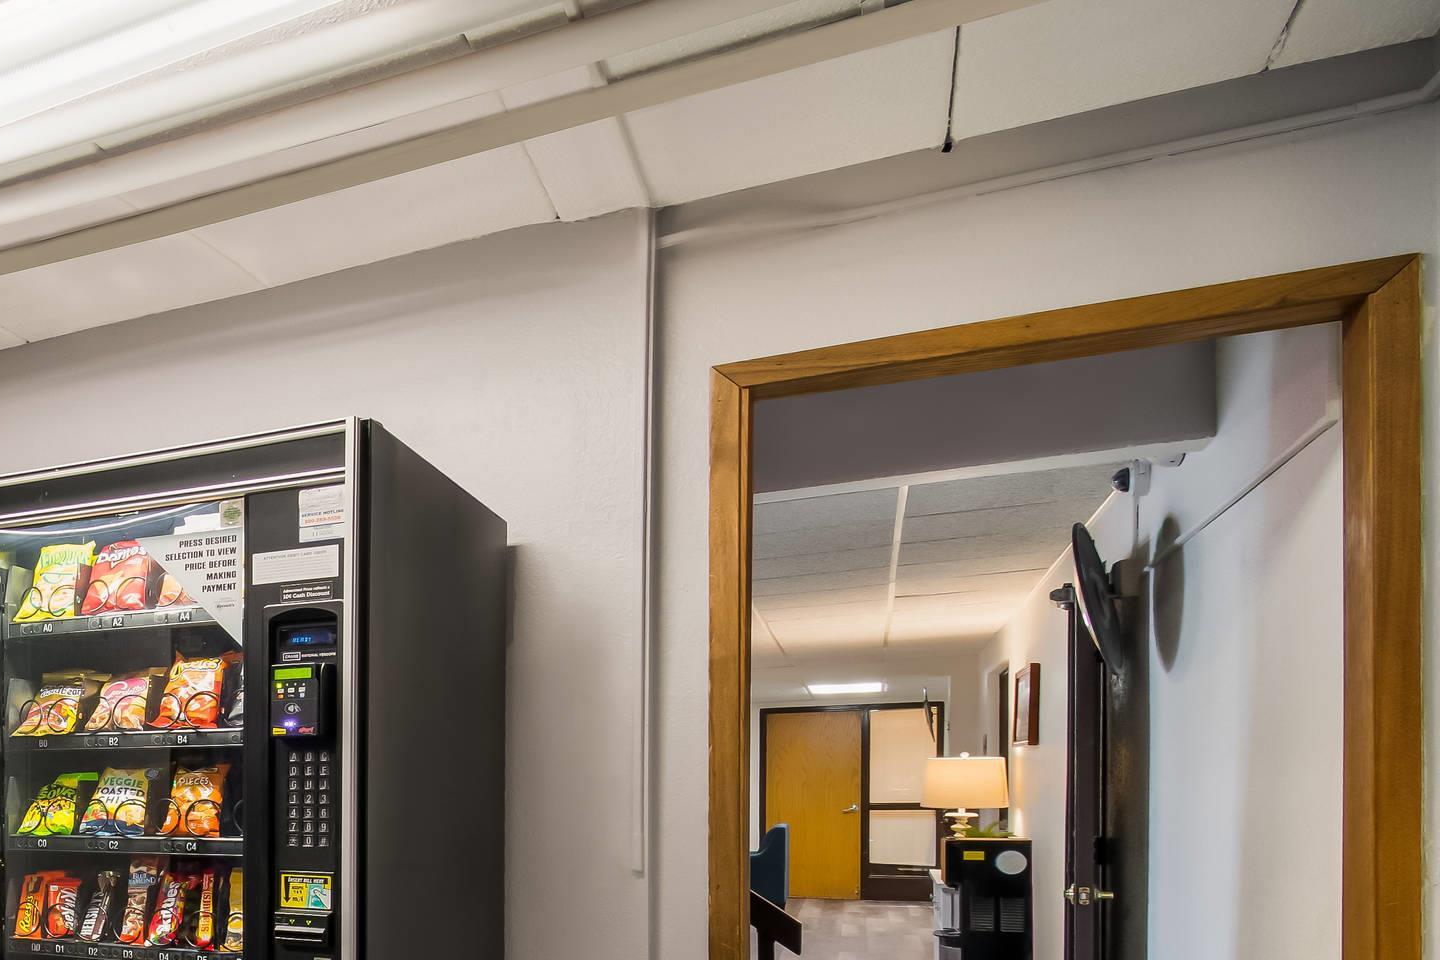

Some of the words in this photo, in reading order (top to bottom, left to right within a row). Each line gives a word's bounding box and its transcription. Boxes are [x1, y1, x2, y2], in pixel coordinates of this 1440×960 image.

[179, 538, 203, 548] PRESS
[205, 534, 237, 546] DESIRED
[98, 545, 147, 562] Doritos
[165, 551, 204, 562] SELECTION
[205, 549, 215, 557] TO
[217, 547, 237, 556] VIEW
[184, 562, 206, 571] PRICE
[208, 559, 237, 569] BEFORE
[206, 570, 237, 581] MAKING
[201, 582, 237, 593] PAYMENT
[43, 623, 53, 633] A0
[112, 617, 123, 627] A2
[179, 612, 190, 621] A4
[38, 739, 48, 748] B0
[108, 737, 119, 746] B2
[177, 735, 187, 744] B4
[103, 776, 145, 788] VEGGIE
[177, 776, 210, 786] PIECES
[36, 785, 76, 800] SOUR
[95, 786, 145, 797] TOASTED
[37, 839, 47, 848] C0
[108, 841, 119, 850] C2
[186, 842, 197, 851] C4
[19, 895, 34, 933] Reese's
[55, 944, 65, 953] D1
[88, 947, 98, 956] D2
[123, 950, 133, 959] D3
[159, 952, 169, 960] D4
